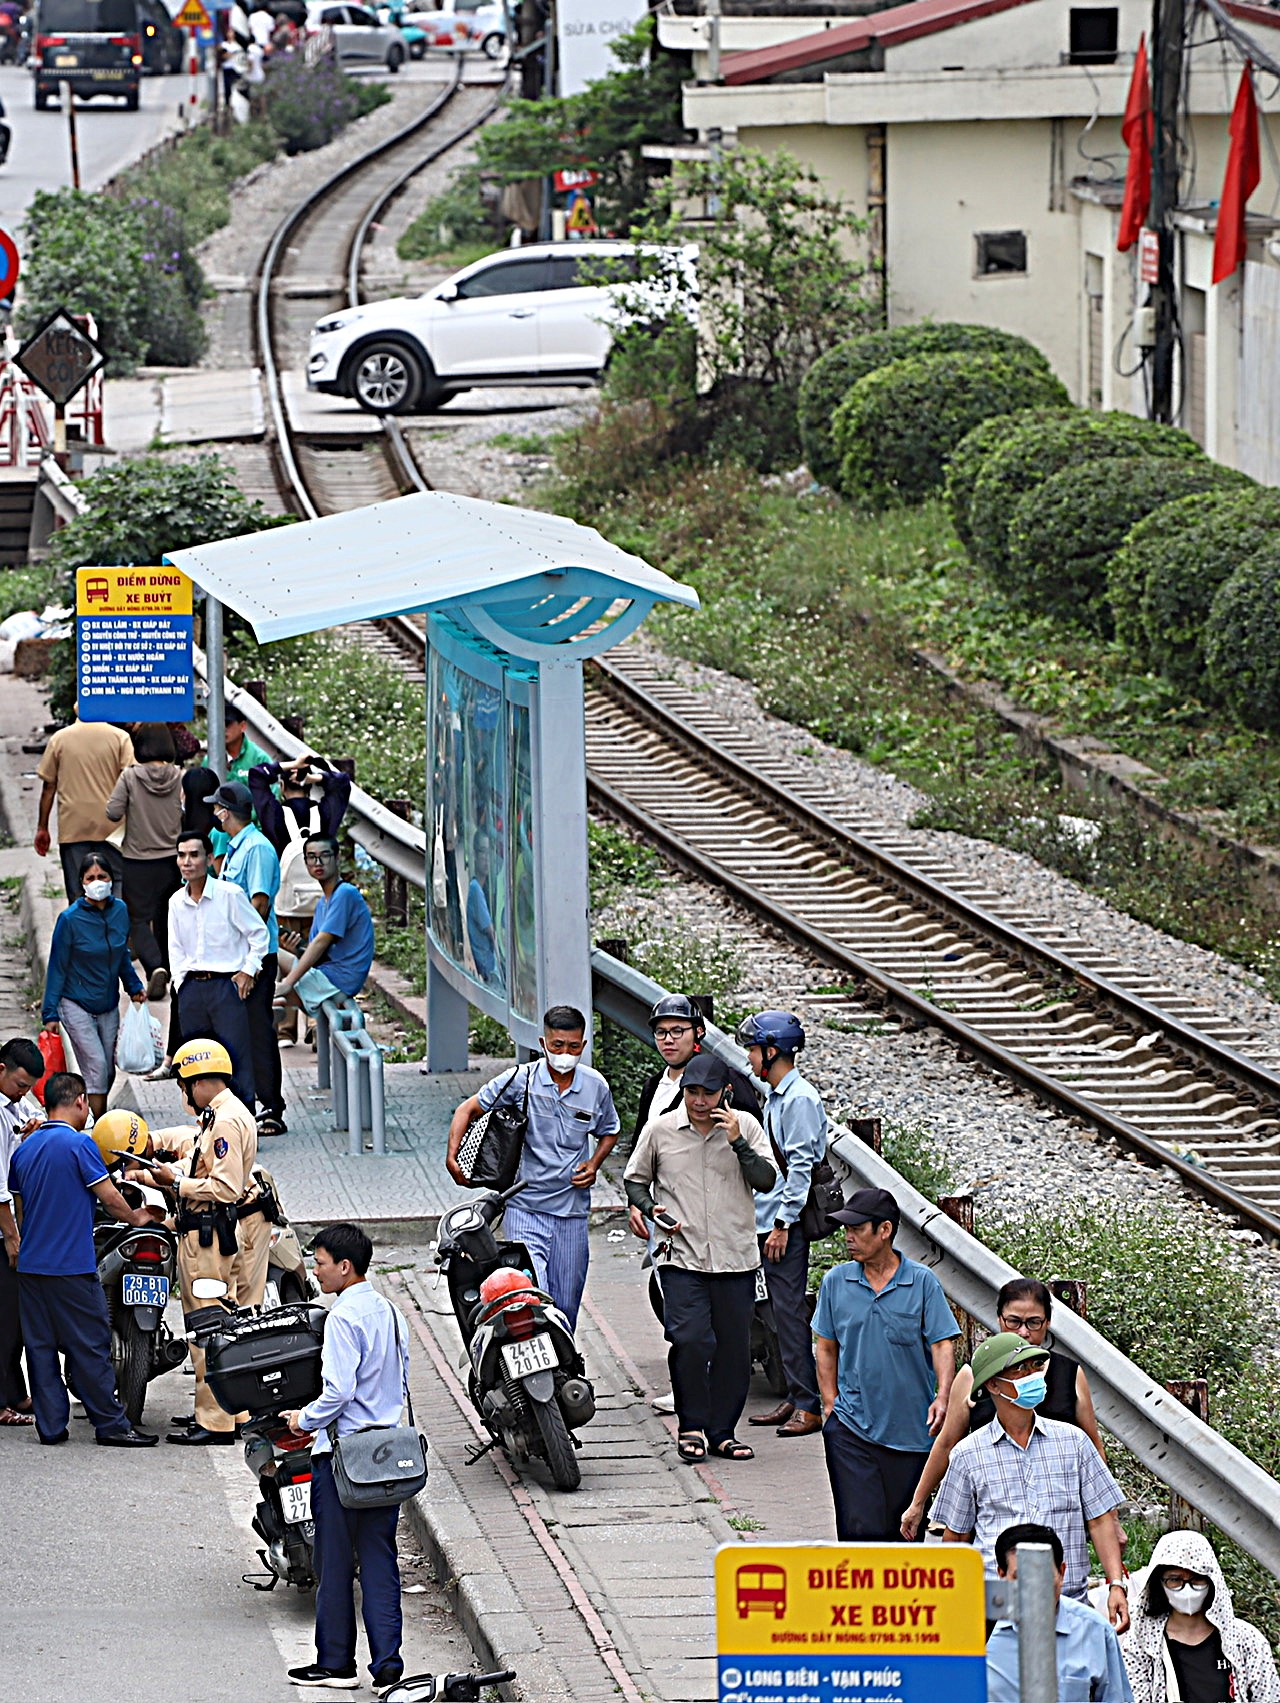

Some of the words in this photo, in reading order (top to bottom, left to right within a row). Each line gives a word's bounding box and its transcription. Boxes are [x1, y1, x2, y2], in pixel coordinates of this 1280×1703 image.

[150, 573, 181, 586] DỪNG
[126, 593, 140, 603] XE
[144, 590, 172, 603] BUÝT
[181, 1051, 211, 1067] CSGT
[128, 1116, 139, 1145] CSGT
[126, 1290, 167, 1305] 006.28
[515, 1353, 551, 1375] 2016
[808, 1559, 874, 1589] ĐIỂM
[883, 1561, 955, 1589] DỪNG
[830, 1606, 863, 1626] XE
[872, 1599, 937, 1626] BUÝT
[745, 1669, 782, 1687] LONG
[785, 1667, 818, 1687] BIÊN
[831, 1670, 861, 1690] VẠN
[863, 1666, 902, 1687] PHÚC
